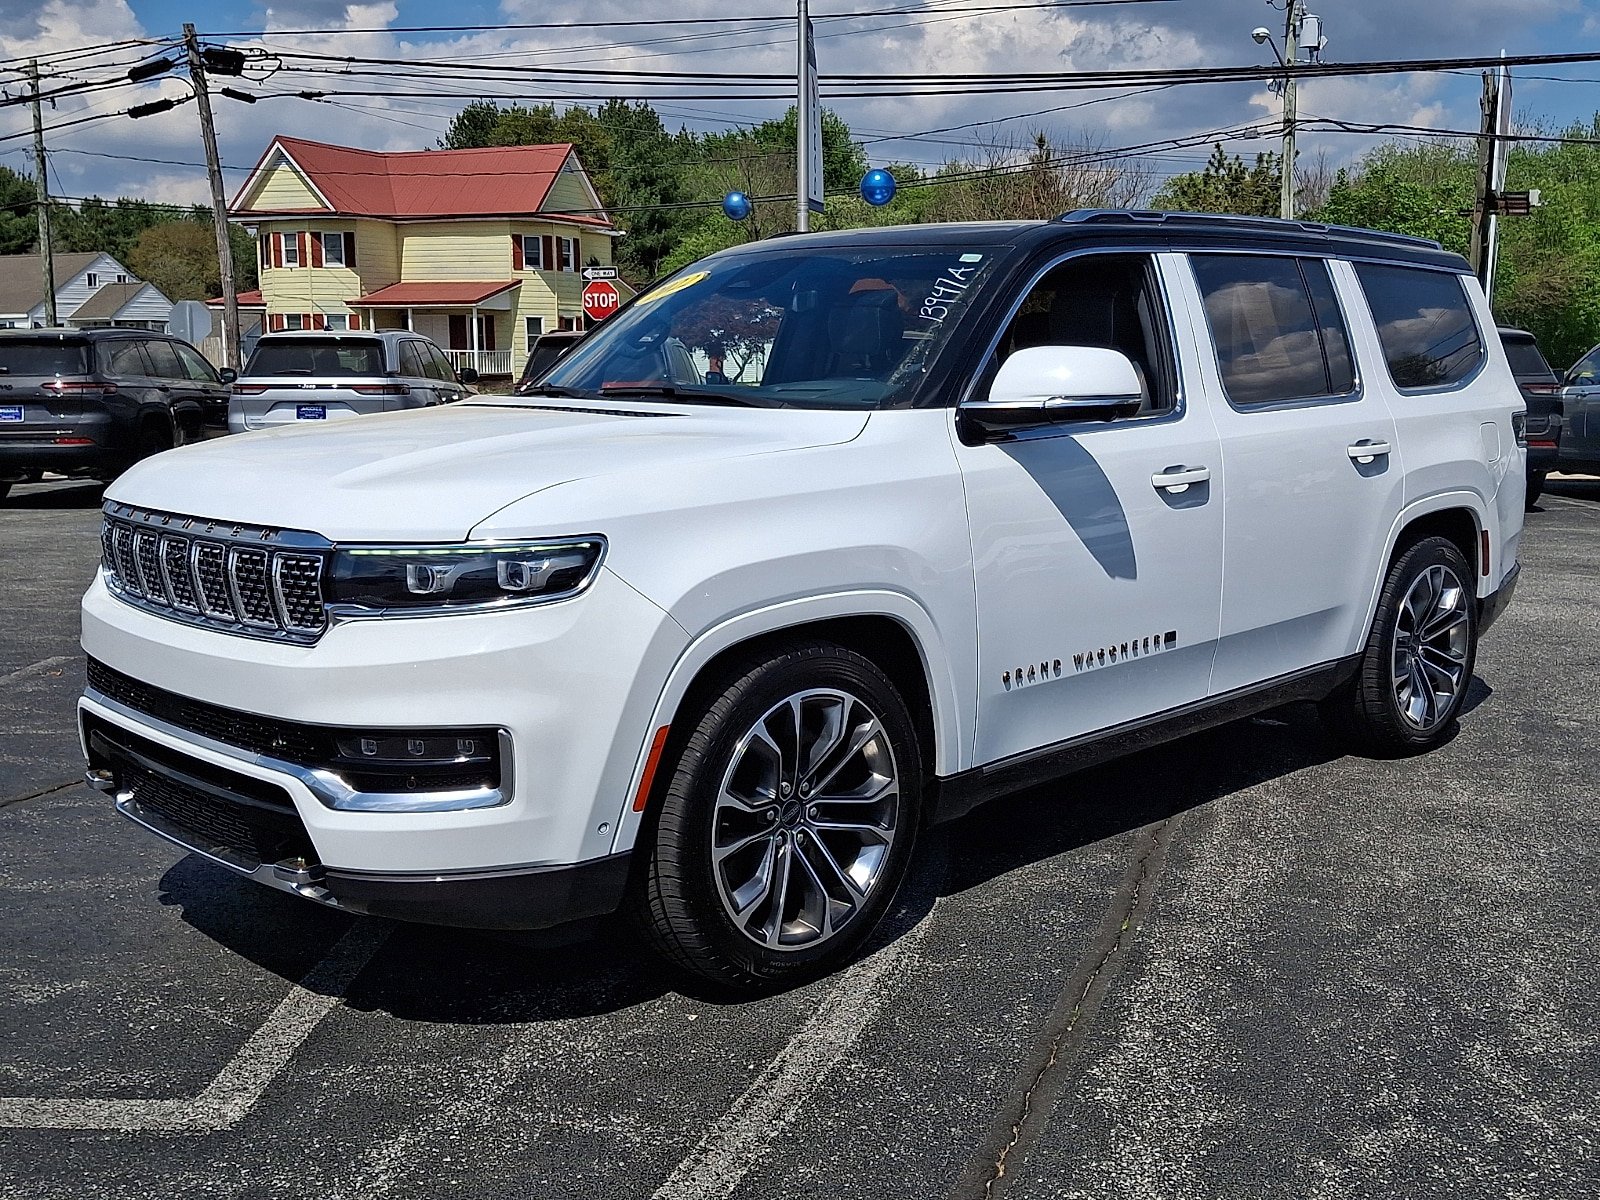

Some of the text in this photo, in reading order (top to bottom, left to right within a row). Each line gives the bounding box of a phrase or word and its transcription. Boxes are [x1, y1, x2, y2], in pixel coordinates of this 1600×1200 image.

[584, 293, 617, 308] STOP
[301, 383, 317, 391] Jeep
[1002, 634, 1161, 688] GRAND WAGONEER
